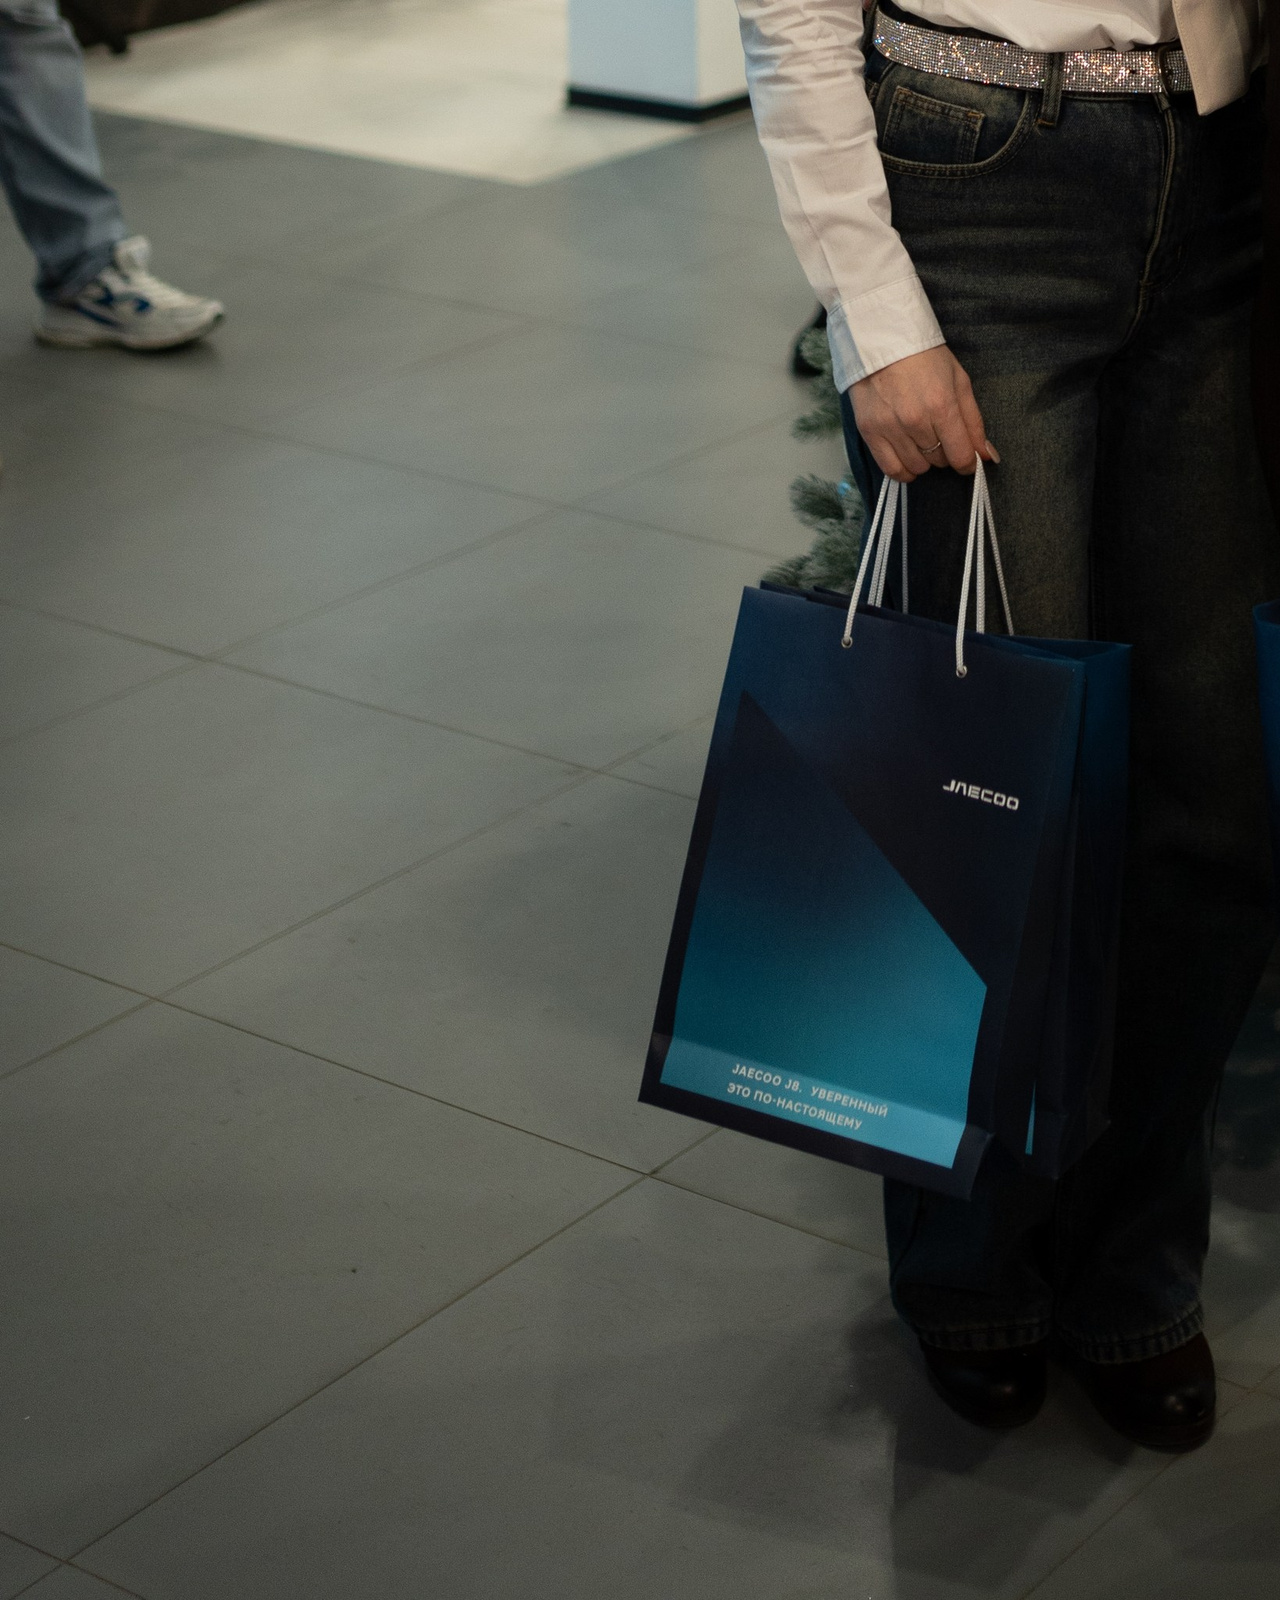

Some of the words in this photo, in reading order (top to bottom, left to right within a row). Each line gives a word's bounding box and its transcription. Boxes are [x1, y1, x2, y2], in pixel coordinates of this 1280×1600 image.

[942, 779, 1019, 811] JAECOO
[727, 1082, 751, 1098] ЭТО
[753, 1090, 863, 1130] ПО-НАСТОЯЩЕМУ
[732, 1064, 782, 1087] JAECOO
[810, 1086, 889, 1117] УВЕРЕННЫЙ
